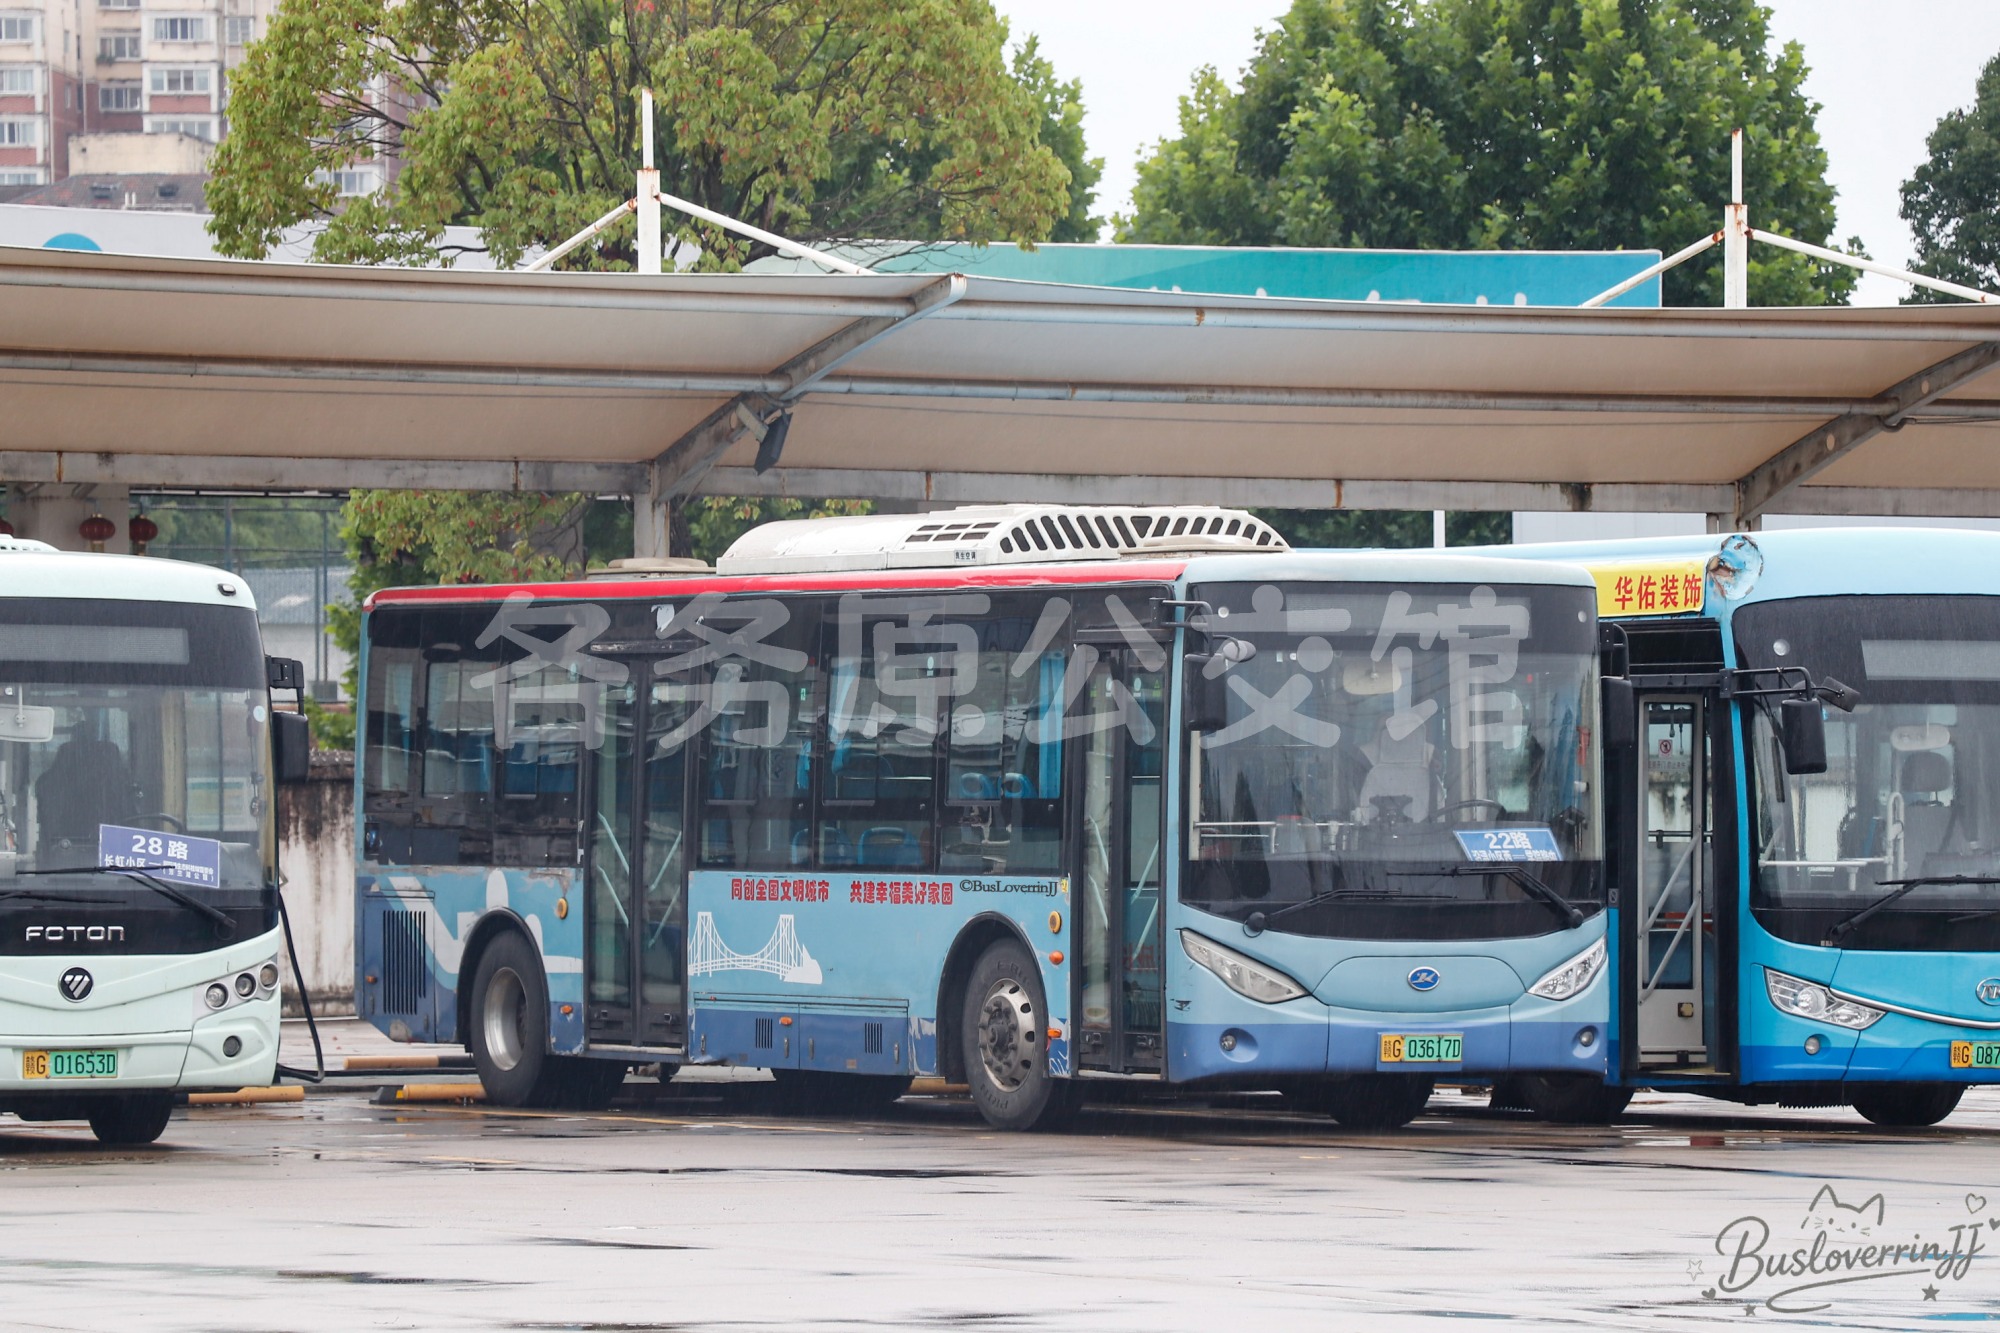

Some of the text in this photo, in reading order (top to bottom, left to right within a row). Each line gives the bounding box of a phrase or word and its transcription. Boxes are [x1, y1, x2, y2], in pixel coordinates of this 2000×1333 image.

[1614, 574, 1702, 610] 华佑装饰
[1483, 831, 1532, 849] 22路
[731, 878, 953, 905] 同创全国文明城市 共建幸福美好家园
[25, 926, 125, 941] FOTON
